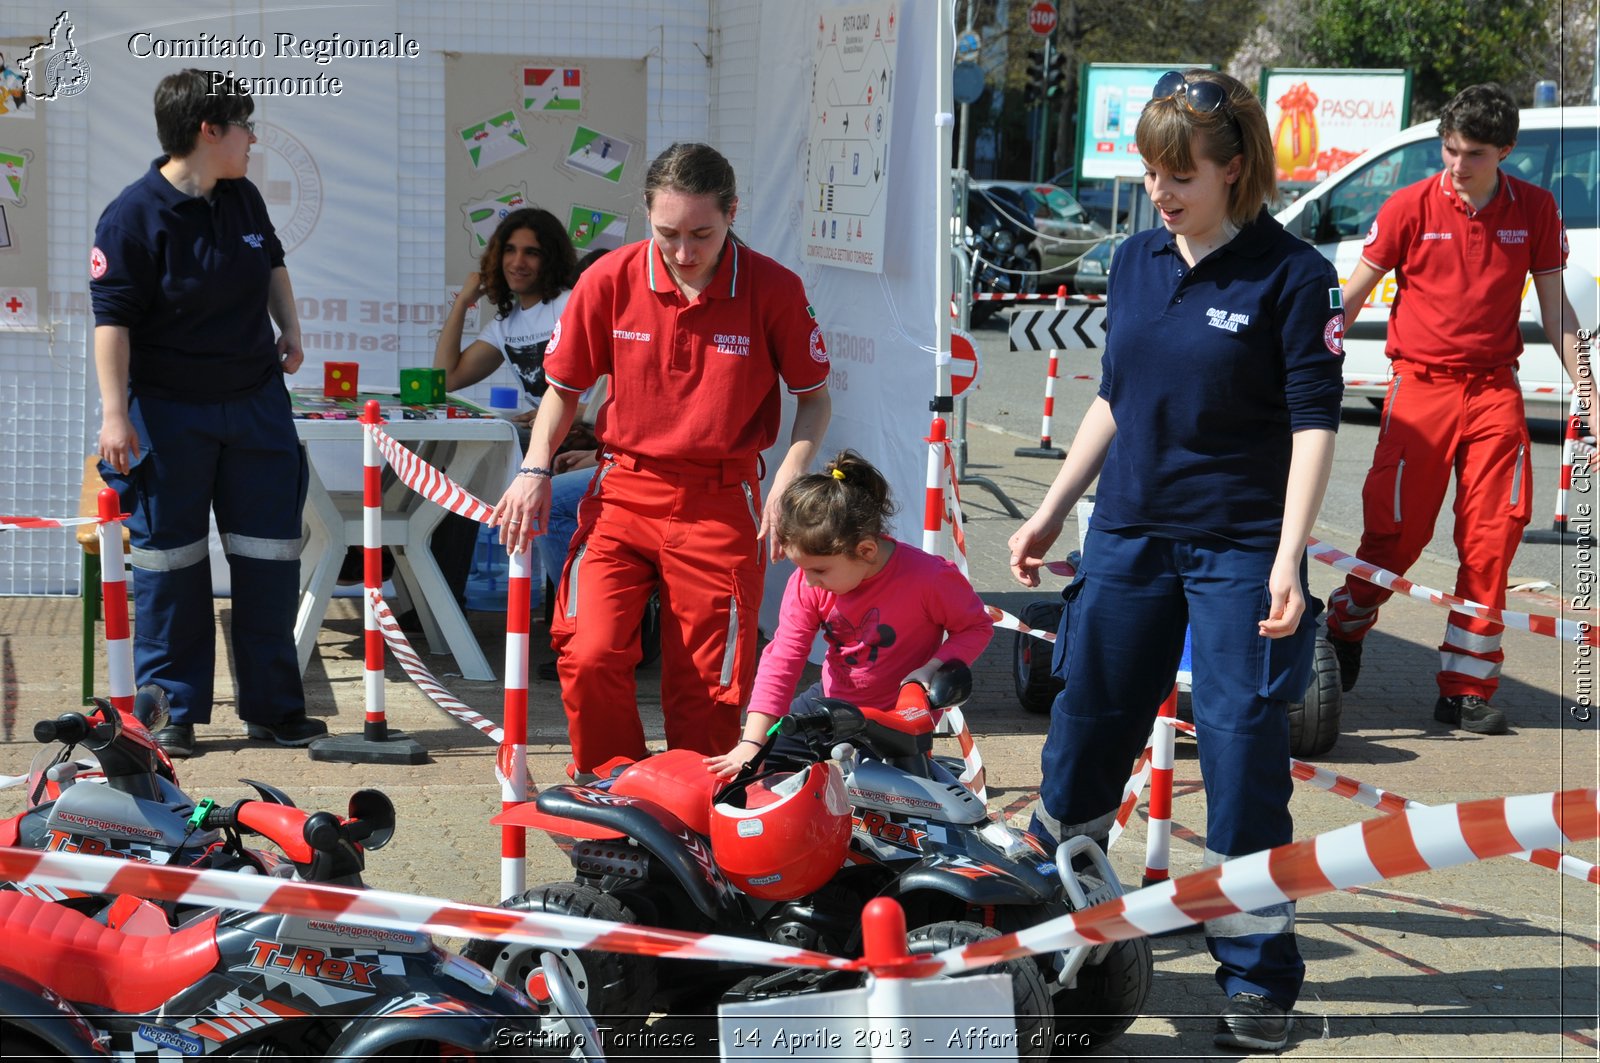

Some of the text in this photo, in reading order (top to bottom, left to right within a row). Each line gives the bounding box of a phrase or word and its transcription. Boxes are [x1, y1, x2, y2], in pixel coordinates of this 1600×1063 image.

[1031, 10, 1057, 26] STOP
[1321, 99, 1396, 119] PASQUA
[1206, 307, 1249, 326] CROCE ROSSA
[1208, 317, 1238, 333] ITALIANA
[713, 333, 737, 344] CROCE
[717, 344, 750, 357] ITALIAN
[58, 811, 163, 840] www.pegperego.com
[850, 805, 933, 851] -Rex
[308, 920, 416, 944] www.pegperego.com
[247, 939, 386, 987] T-Rex
